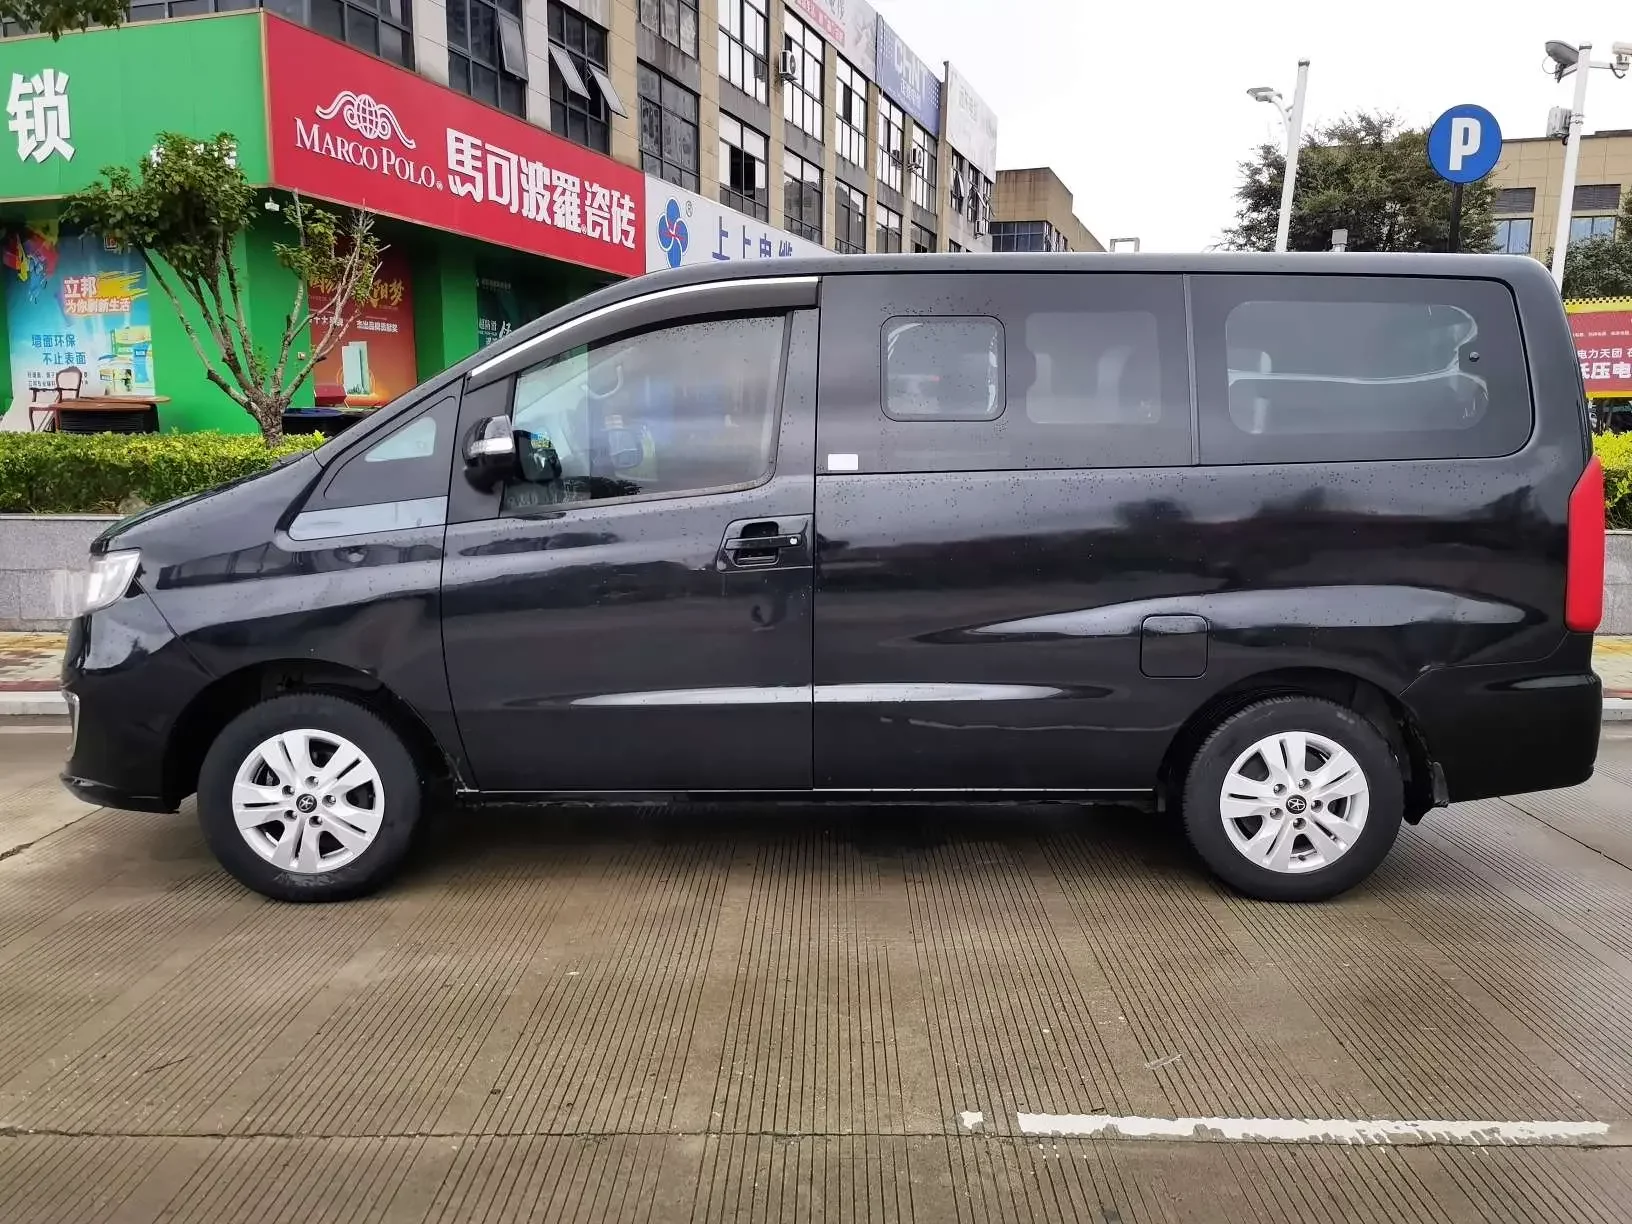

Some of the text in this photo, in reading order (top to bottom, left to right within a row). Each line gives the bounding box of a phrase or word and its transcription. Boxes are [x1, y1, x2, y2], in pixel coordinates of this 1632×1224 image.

[7, 68, 76, 163] 锁
[295, 116, 378, 171] MARCO
[382, 146, 436, 188] POLO
[1449, 117, 1481, 171] P
[63, 275, 97, 298] 立邦
[31, 333, 76, 348] 墙面环保
[42, 351, 87, 366] 不止表面
[1577, 347, 1623, 359] 电力天团
